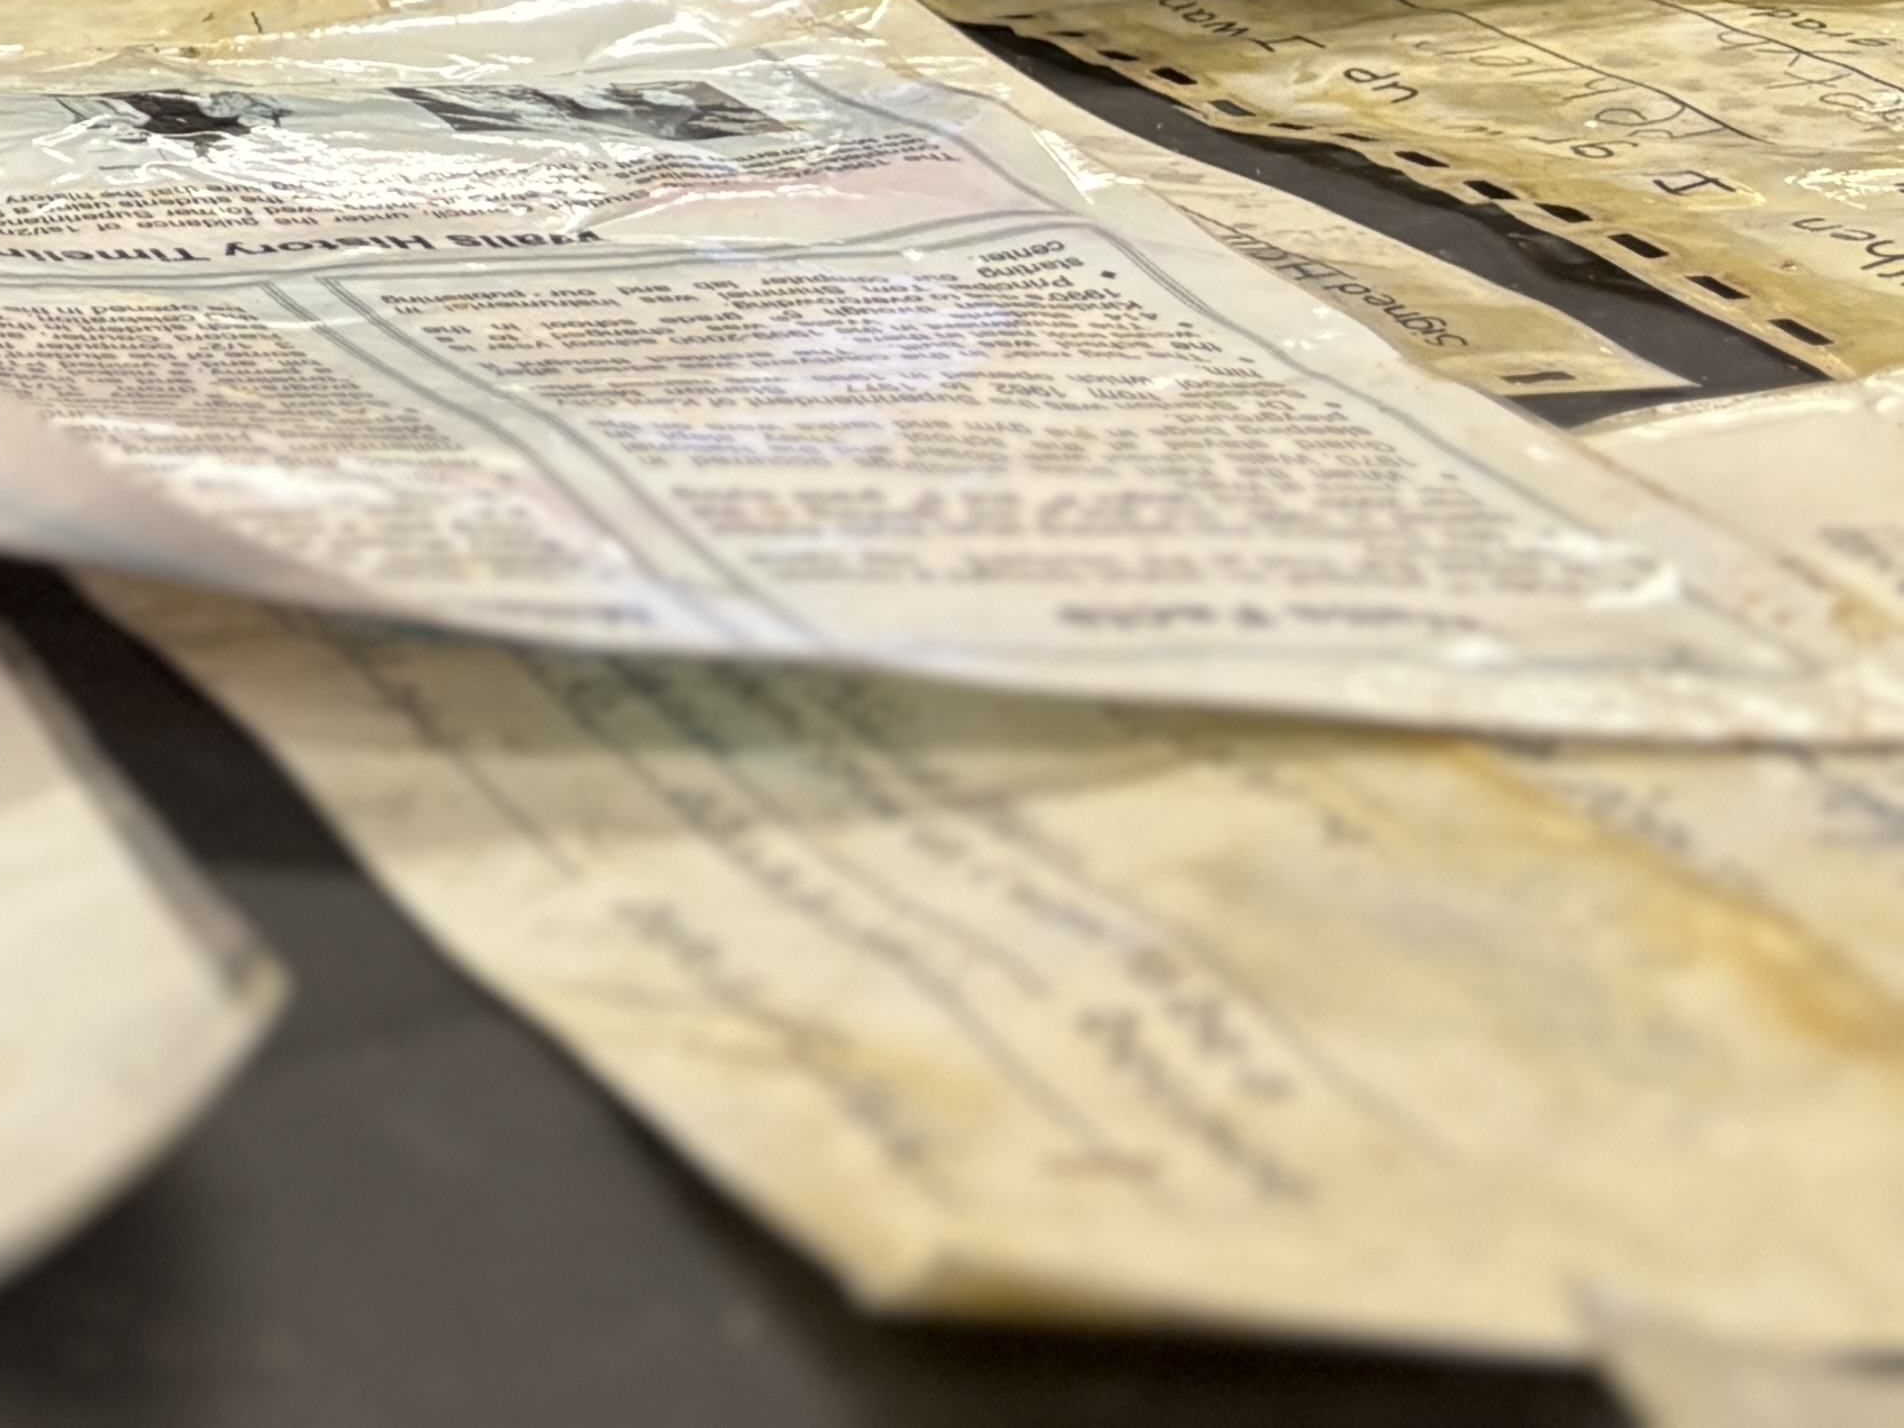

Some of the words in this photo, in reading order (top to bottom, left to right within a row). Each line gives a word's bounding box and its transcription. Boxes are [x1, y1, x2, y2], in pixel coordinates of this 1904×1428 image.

[1342, 66, 1419, 104] up
[116, 196, 233, 208] students
[135, 215, 260, 230] guidance
[271, 216, 319, 226] the
[332, 211, 409, 223] under
[225, 235, 435, 257] History
[964, 240, 1066, 263] center.
[974, 257, 1085, 278] starting
[759, 273, 891, 285] computer
[908, 273, 960, 283] our
[616, 285, 671, 295] and
[692, 280, 737, 291] lab
[378, 289, 525, 305] publishing
[548, 289, 597, 297] our
[715, 285, 846, 299] Shimmel
[441, 299, 621, 310] instrumental
[637, 294, 700, 304] was
[722, 295, 924, 310] overcrowding.
[89, 304, 199, 315] opened
[822, 305, 937, 317] through
[1336, 278, 1470, 348] Signed
[538, 320, 635, 329] school
[657, 313, 744, 324] grade
[422, 325, 471, 335] the
[744, 392, 982, 406] Superintendent
